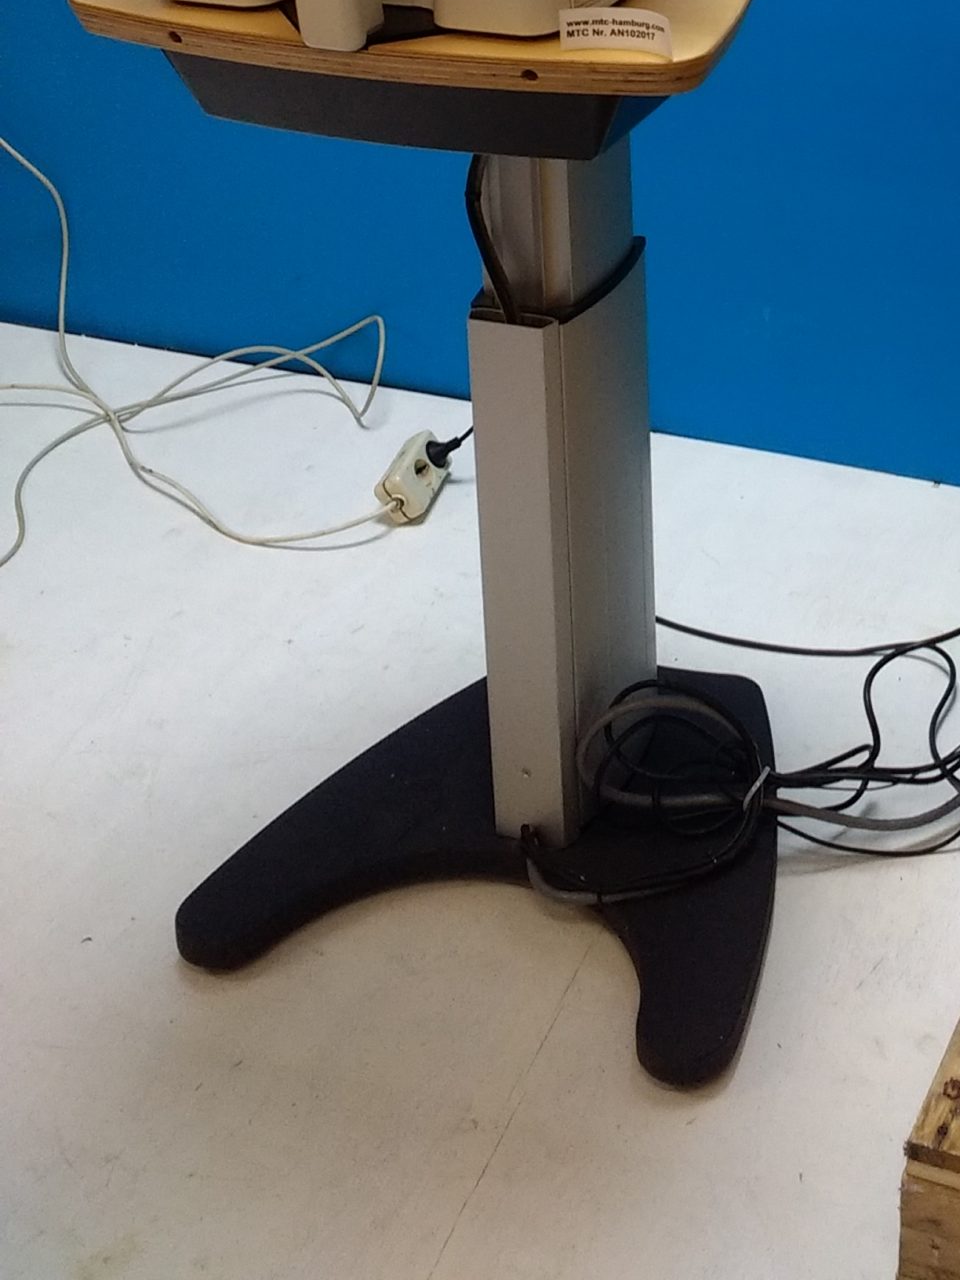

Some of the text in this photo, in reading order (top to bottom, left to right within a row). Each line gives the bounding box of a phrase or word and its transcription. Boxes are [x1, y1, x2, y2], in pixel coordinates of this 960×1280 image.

[566, 18, 666, 33] www.mtc-hamburg.com
[566, 28, 656, 41] MTC Nr. AN102017
